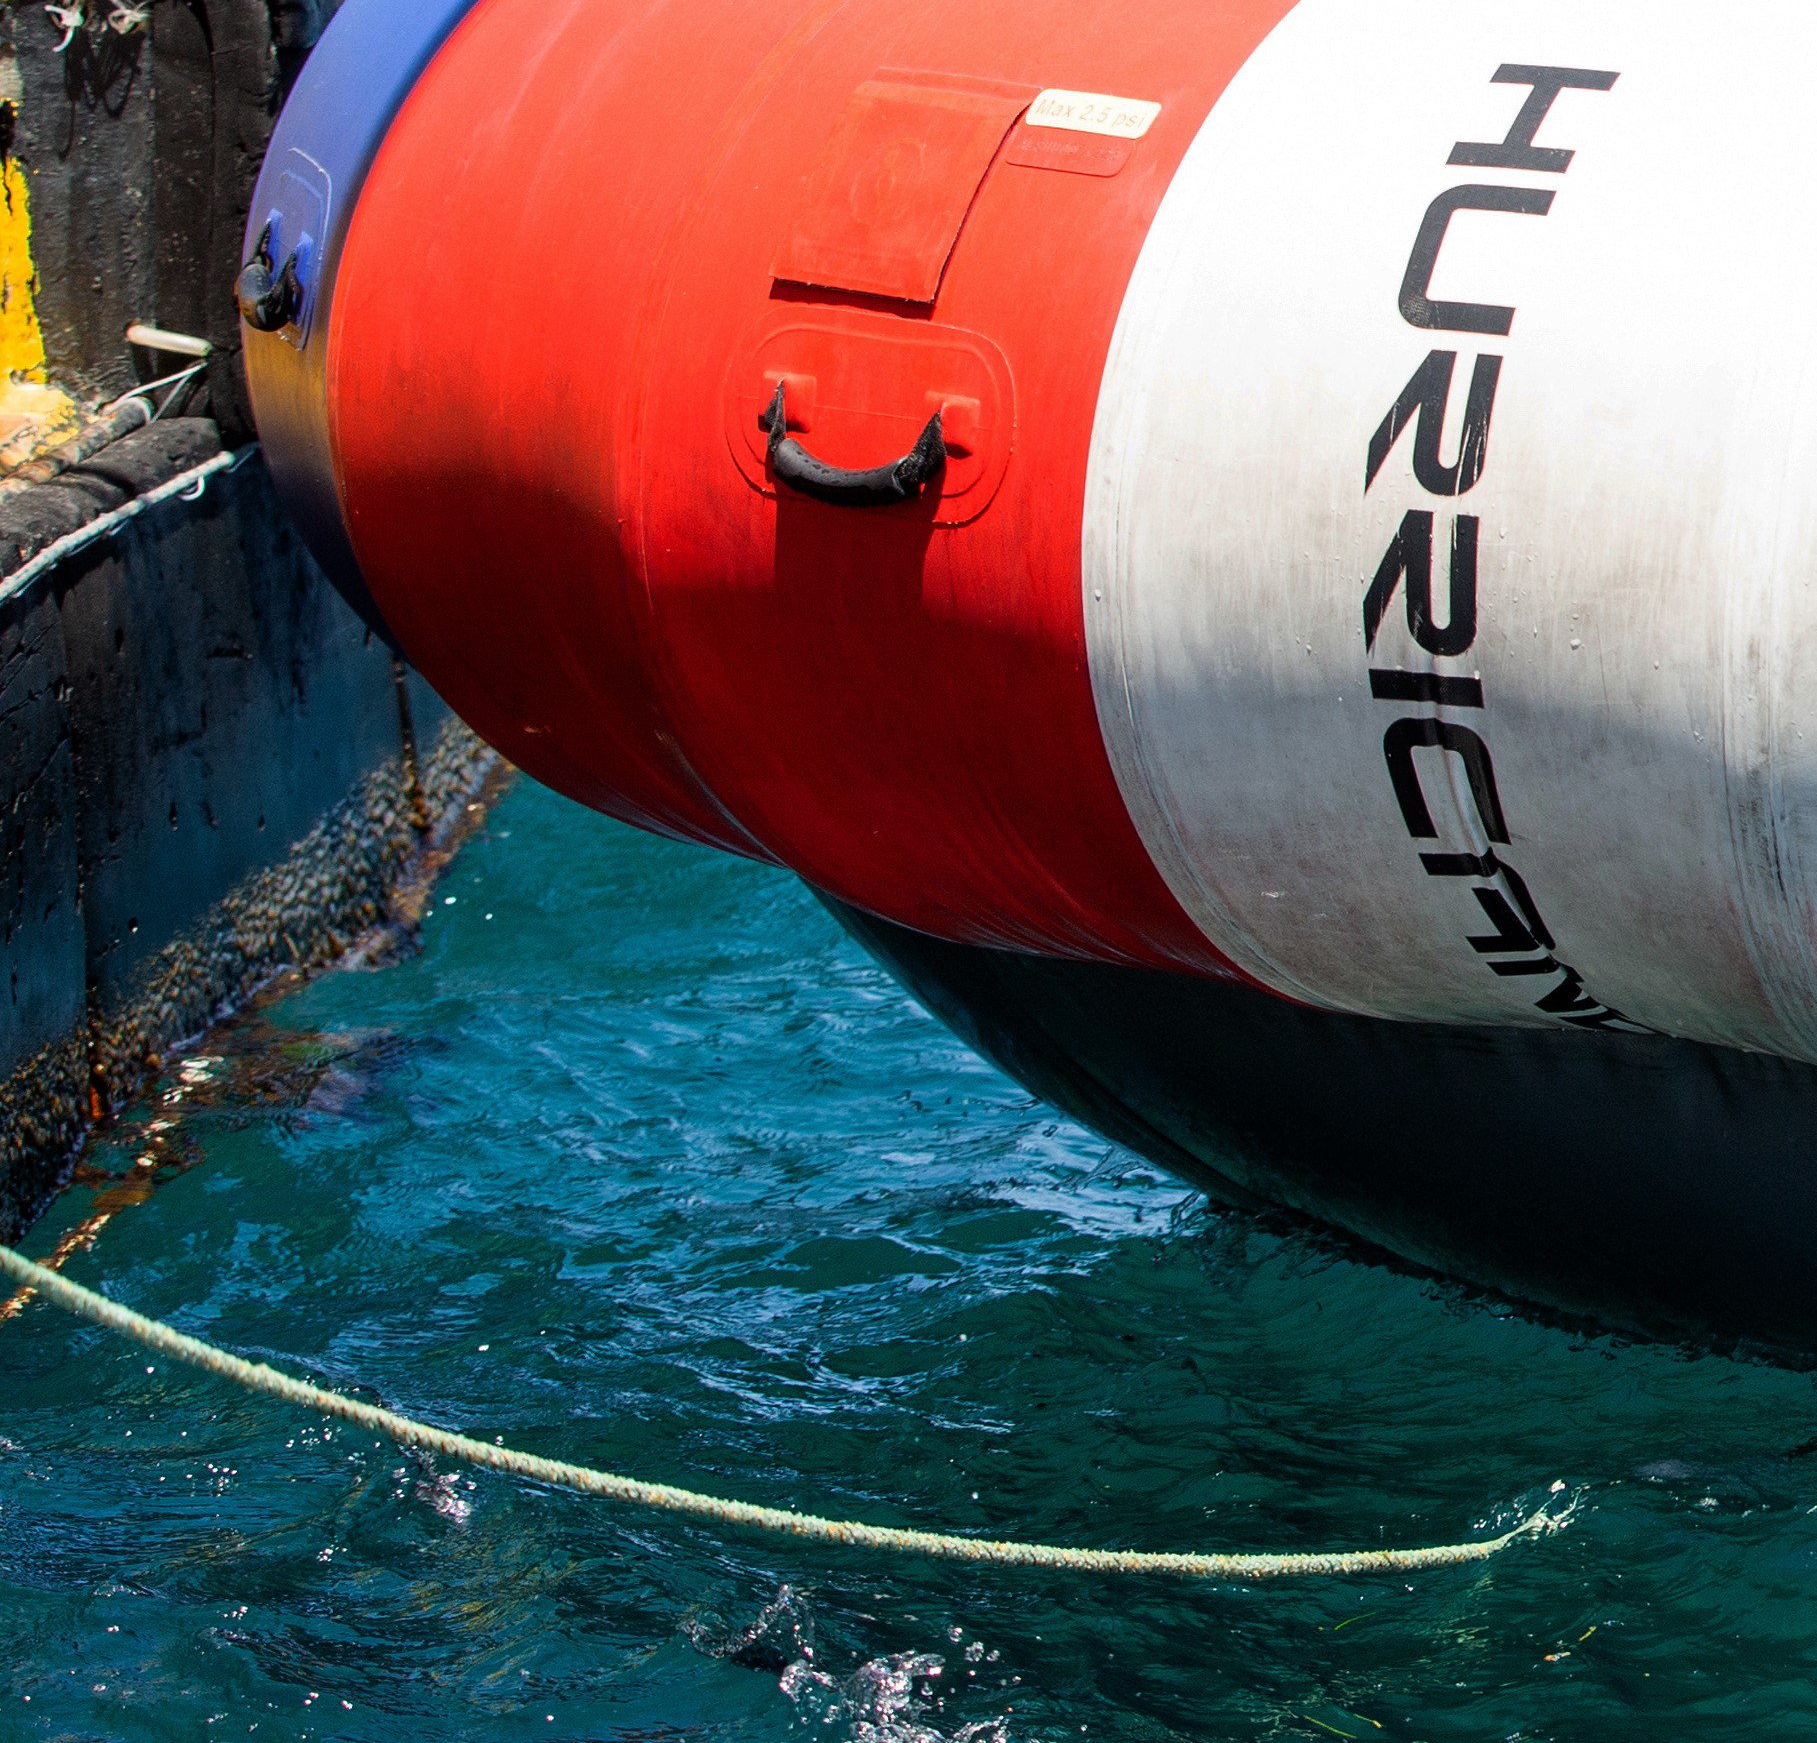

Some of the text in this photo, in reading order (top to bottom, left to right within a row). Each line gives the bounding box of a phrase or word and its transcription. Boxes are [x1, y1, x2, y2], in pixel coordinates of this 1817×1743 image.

[1035, 98, 1148, 129] Max 2.5 psi
